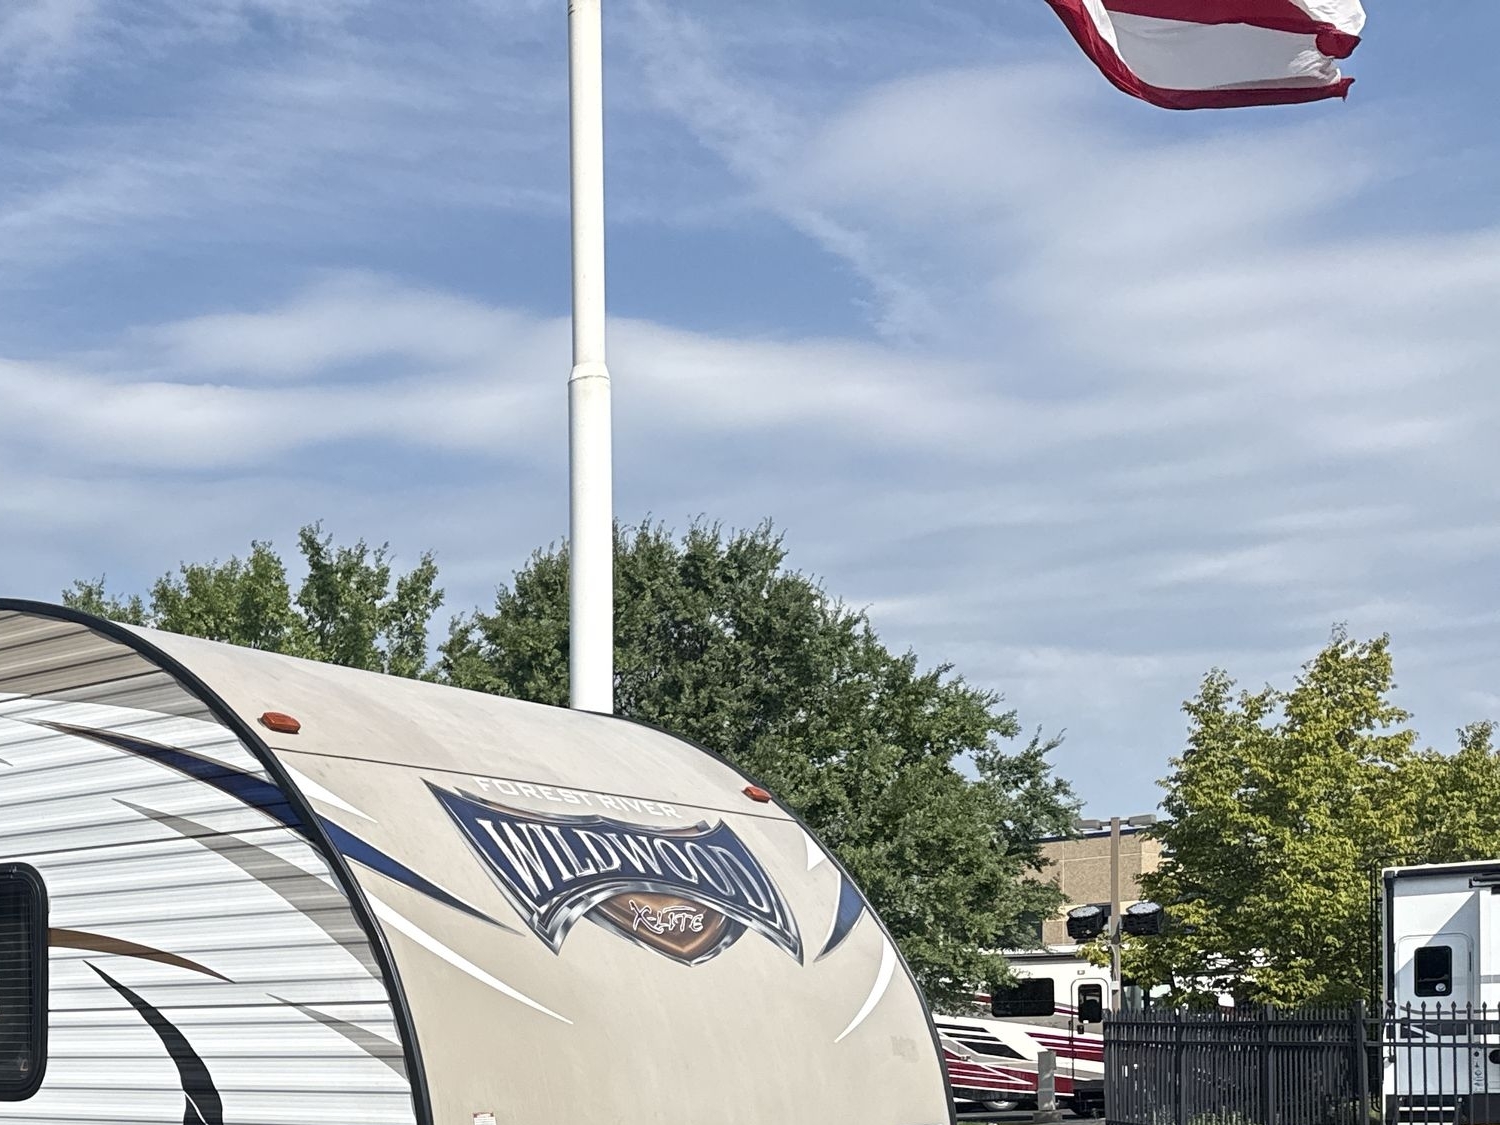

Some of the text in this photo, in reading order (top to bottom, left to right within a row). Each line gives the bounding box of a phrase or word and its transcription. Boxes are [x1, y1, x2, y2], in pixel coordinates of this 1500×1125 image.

[471, 775, 684, 819] FOREST RIVER
[476, 817, 772, 914] WILDWOOD
[628, 899, 705, 935] X-LITE
